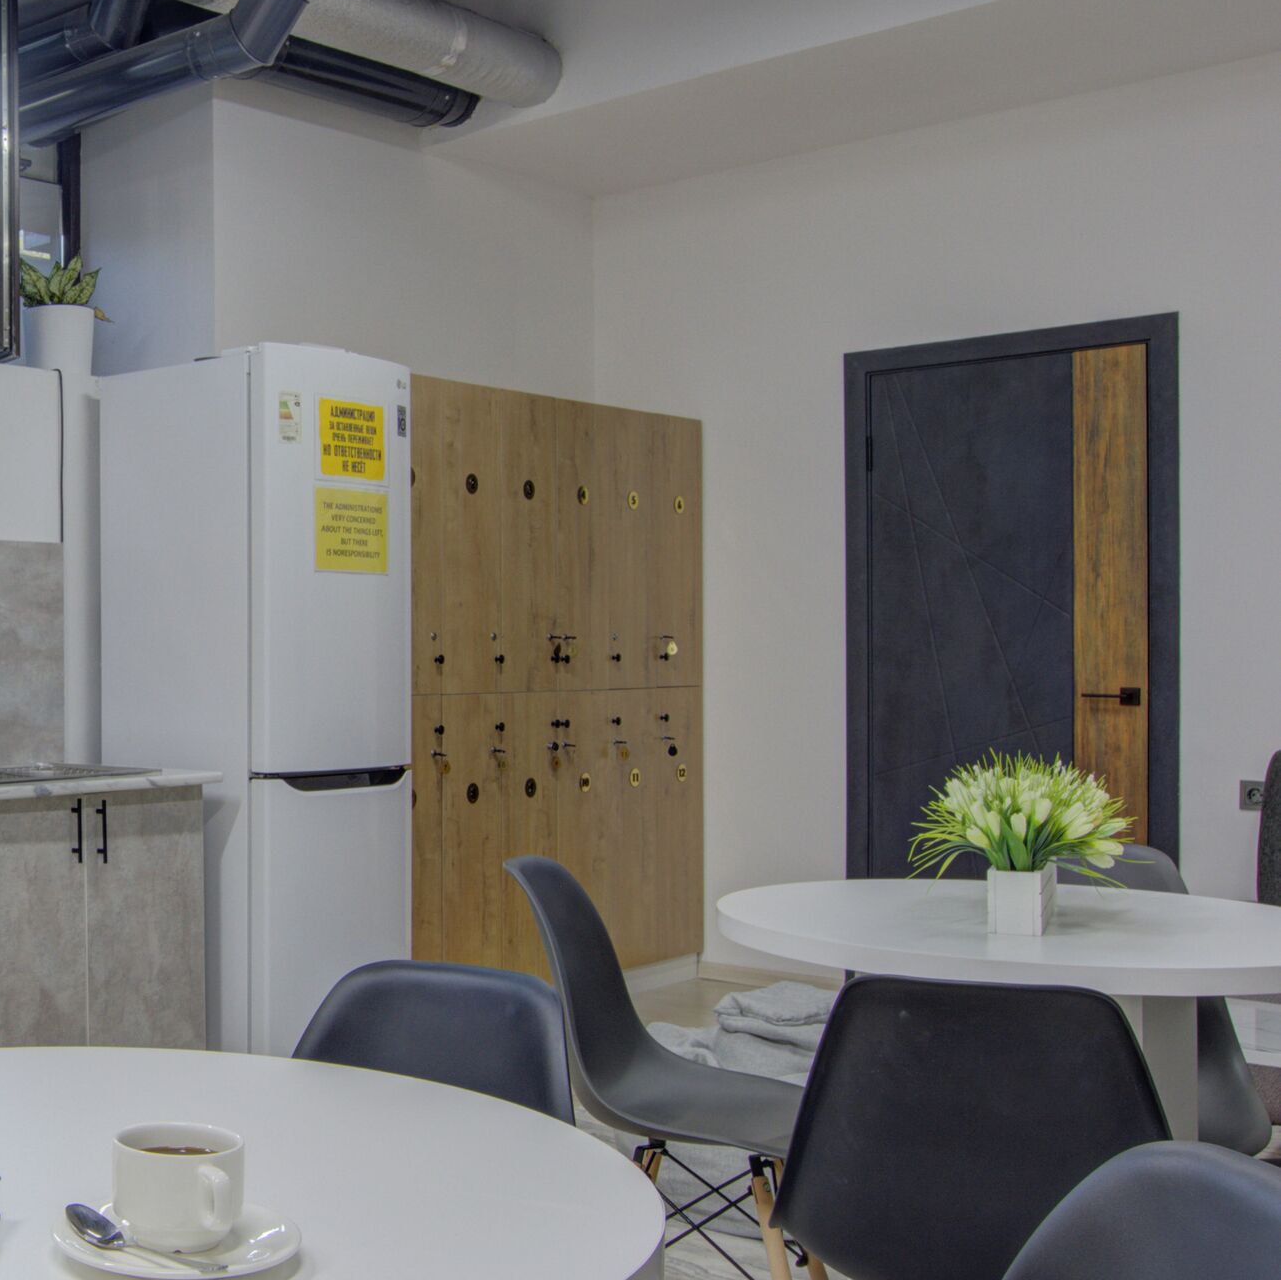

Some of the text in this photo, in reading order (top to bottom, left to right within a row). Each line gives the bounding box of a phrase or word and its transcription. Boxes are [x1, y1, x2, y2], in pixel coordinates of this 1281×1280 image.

[323, 443, 331, 456] НО
[342, 460, 349, 472] НЕ
[323, 501, 333, 510] THE
[331, 514, 376, 524] VERY CONCERNED
[321, 525, 341, 533] ABOUT
[343, 526, 352, 534] THE
[352, 538, 368, 546] THERE
[678, 768, 685, 777] 12
